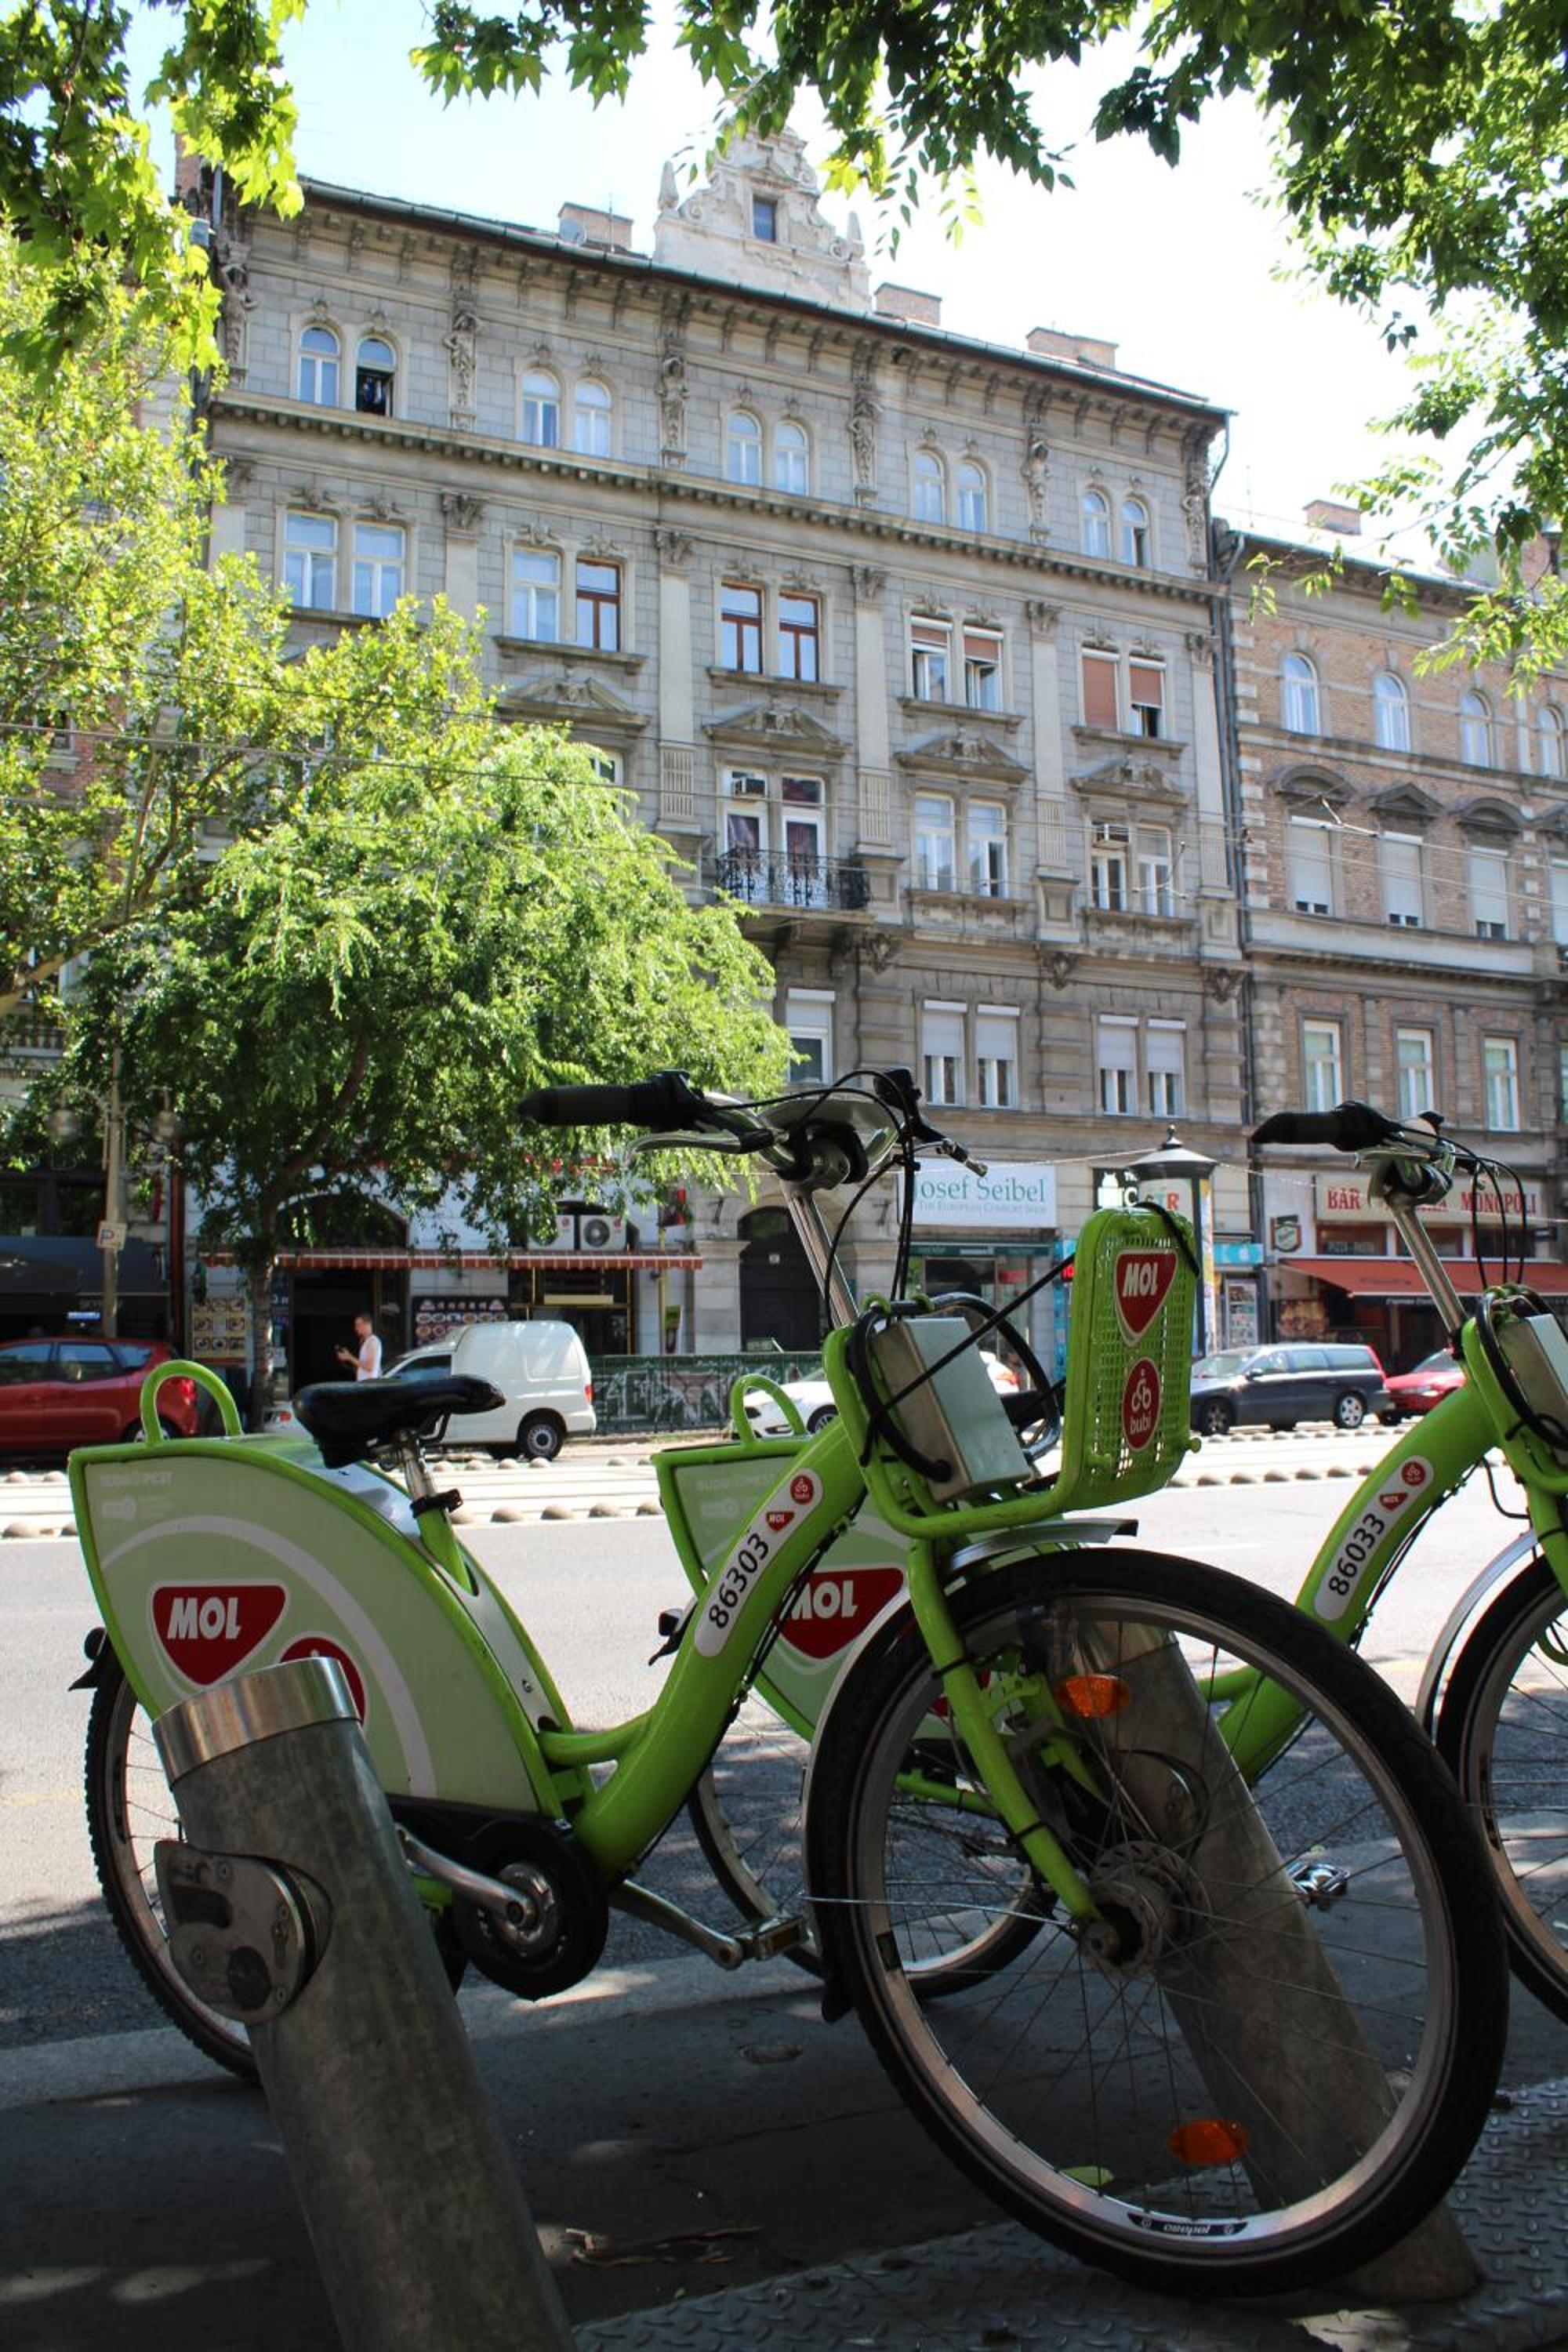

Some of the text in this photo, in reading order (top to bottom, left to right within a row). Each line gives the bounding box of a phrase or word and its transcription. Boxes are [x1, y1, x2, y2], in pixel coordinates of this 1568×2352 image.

[976, 1177, 1045, 1203] Seibel
[1327, 1189, 1362, 1210] BAR
[1122, 1261, 1159, 1298] MOL
[1130, 1410, 1152, 1435] bubi
[769, 1514, 786, 1523] MOL
[1328, 1513, 1385, 1596] 86033
[709, 1533, 769, 1629] 86303
[167, 1597, 241, 1640] MOL
